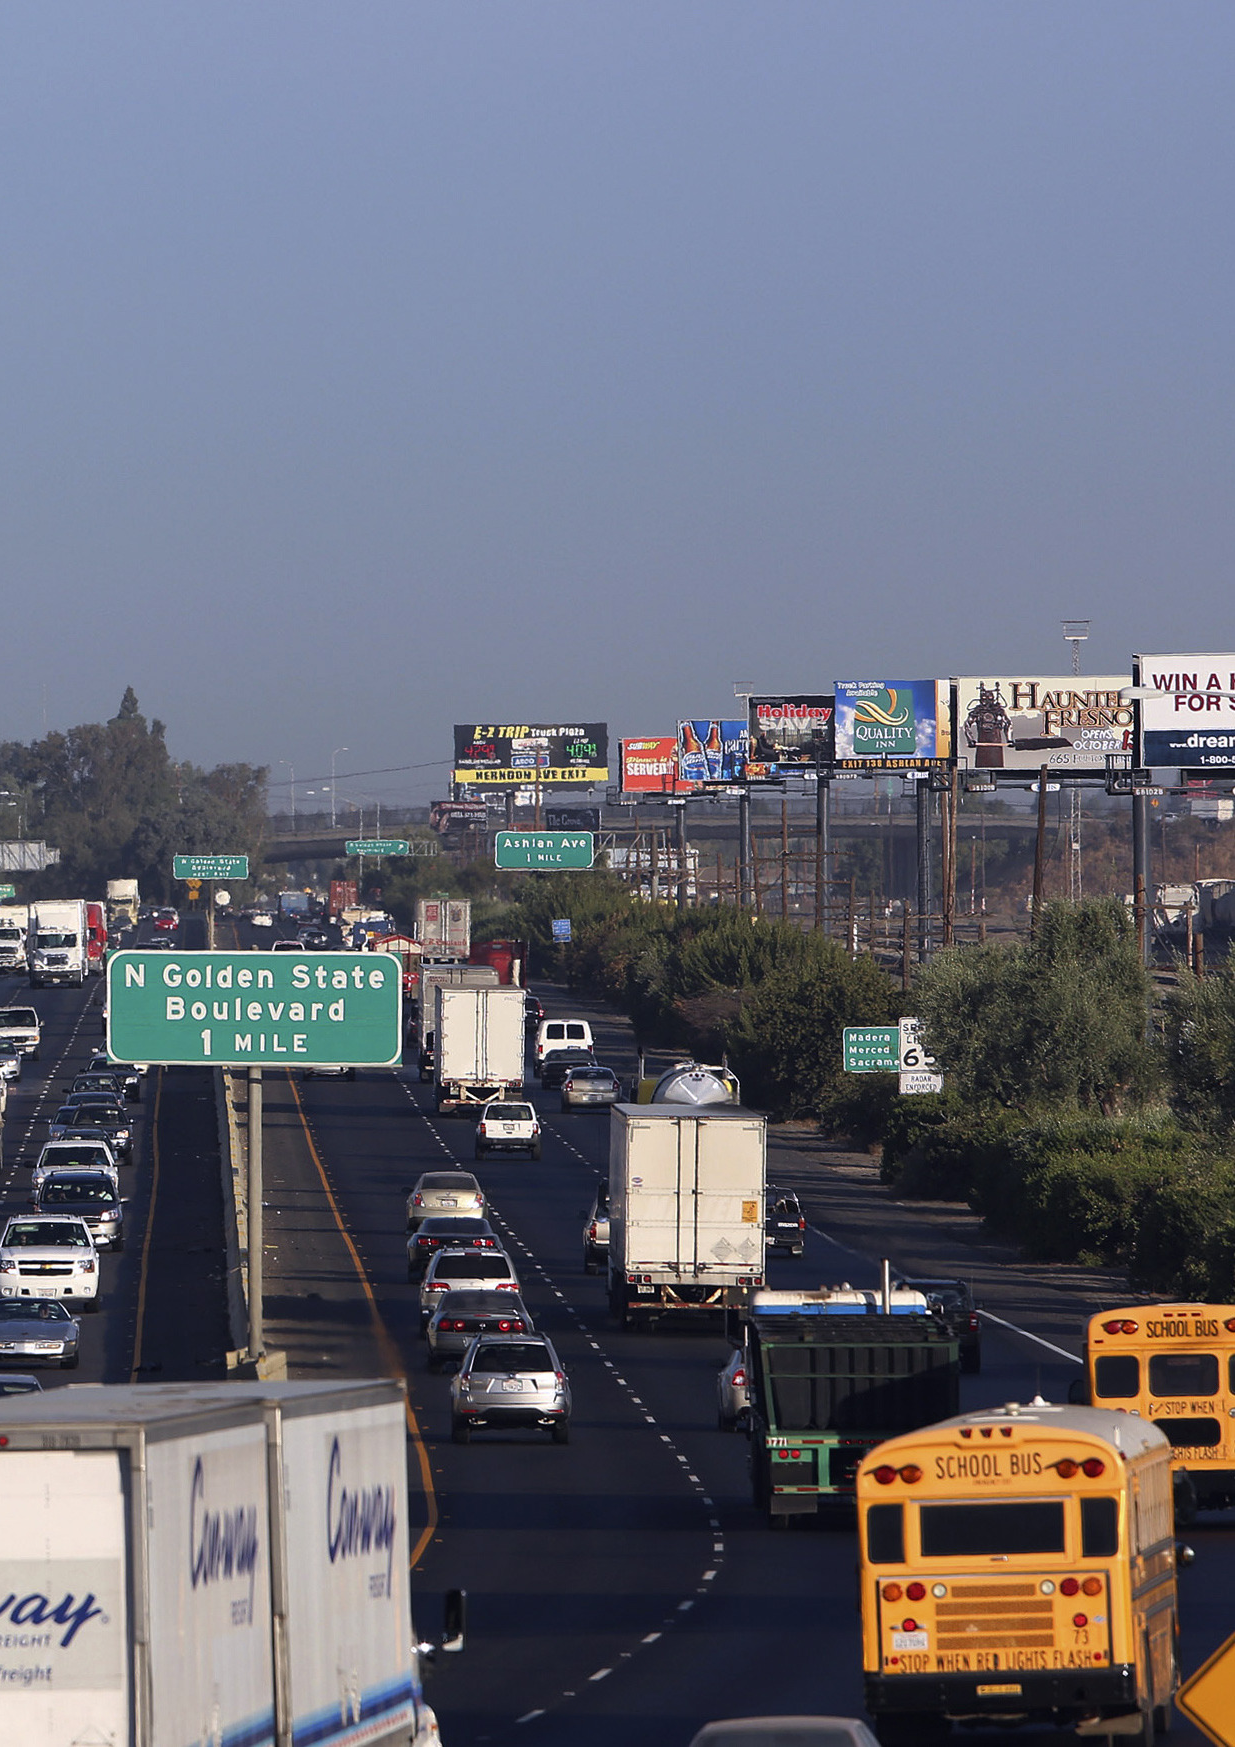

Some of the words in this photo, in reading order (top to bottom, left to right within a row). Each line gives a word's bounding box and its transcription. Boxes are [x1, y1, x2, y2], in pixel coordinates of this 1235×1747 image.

[1152, 673, 1198, 691] WIN
[1206, 673, 1222, 690] A
[1009, 682, 1133, 711] HAUNTED
[1174, 695, 1222, 712] FOR
[757, 704, 833, 720] Holiday
[1040, 708, 1133, 737] FRESNO
[474, 726, 495, 740] E-Z
[498, 726, 530, 739] TRIP
[531, 728, 558, 737] Truck
[559, 727, 585, 737] Plaza
[856, 725, 913, 741] QUALITY
[1082, 729, 1113, 740] OPENS
[627, 741, 661, 751] SUBWAY
[1072, 741, 1121, 750] OCTOBER
[842, 760, 864, 769] EXIT
[1049, 753, 1070, 764] 665
[475, 770, 532, 781] HERNDON
[561, 769, 587, 780] EXIT
[503, 837, 554, 849] Ashlan
[560, 837, 587, 848] Ave
[537, 853, 562, 862] MILE
[125, 963, 146, 988] N
[162, 963, 275, 989] Golden
[291, 964, 386, 989] State
[165, 996, 345, 1022] Boulevard
[201, 1029, 212, 1055] 1
[235, 1033, 308, 1053] MILE
[849, 1033, 891, 1042] Madera
[849, 1045, 890, 1054] Merced
[849, 1057, 900, 1067] Sacrame
[910, 1075, 933, 1083] RADAR
[905, 1082, 937, 1091] ENFORCED
[1146, 1320, 1192, 1339] SCHOOL
[1195, 1319, 1219, 1337] BUS
[1165, 1401, 1187, 1415] STOP
[1190, 1400, 1215, 1414] WHEN
[1194, 1446, 1218, 1460] FLASH
[935, 1454, 1002, 1479] SCHOOL
[1010, 1452, 1043, 1475] BUS
[1073, 1629, 1090, 1646] 73
[899, 1654, 930, 1674] STOP
[936, 1652, 971, 1672] WHEN
[977, 1652, 1000, 1671] RED
[1005, 1650, 1048, 1671] LIGHTS
[1054, 1649, 1093, 1669] FLASH
